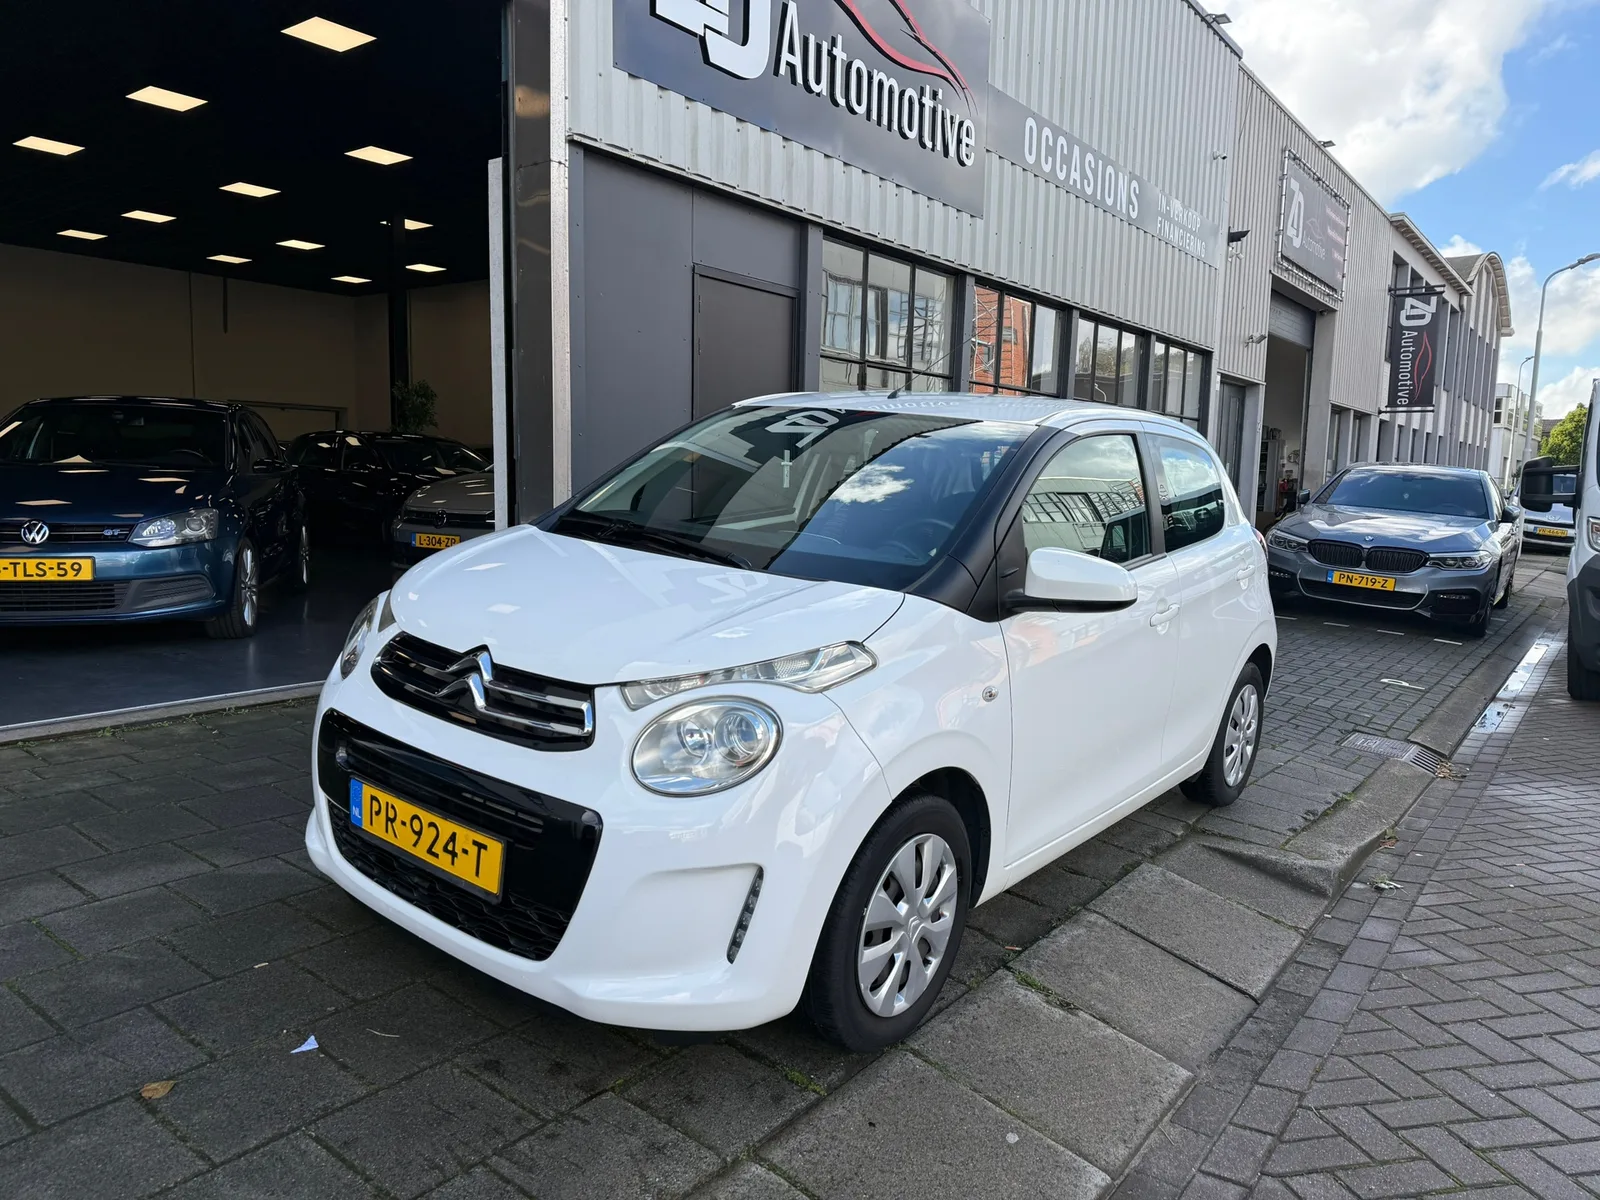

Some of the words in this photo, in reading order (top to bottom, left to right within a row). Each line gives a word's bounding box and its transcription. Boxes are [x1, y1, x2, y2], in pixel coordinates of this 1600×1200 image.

[774, 0, 976, 167] Automotive
[1024, 117, 1140, 219] OCCASIONS
[1157, 216, 1206, 258] FINANCIERING
[1397, 330, 1418, 405] Automotive
[0, 561, 83, 578] -TLS-59
[1338, 573, 1389, 589] PN-719-Z
[352, 805, 362, 819] NL
[369, 794, 488, 878] PR-924-T
